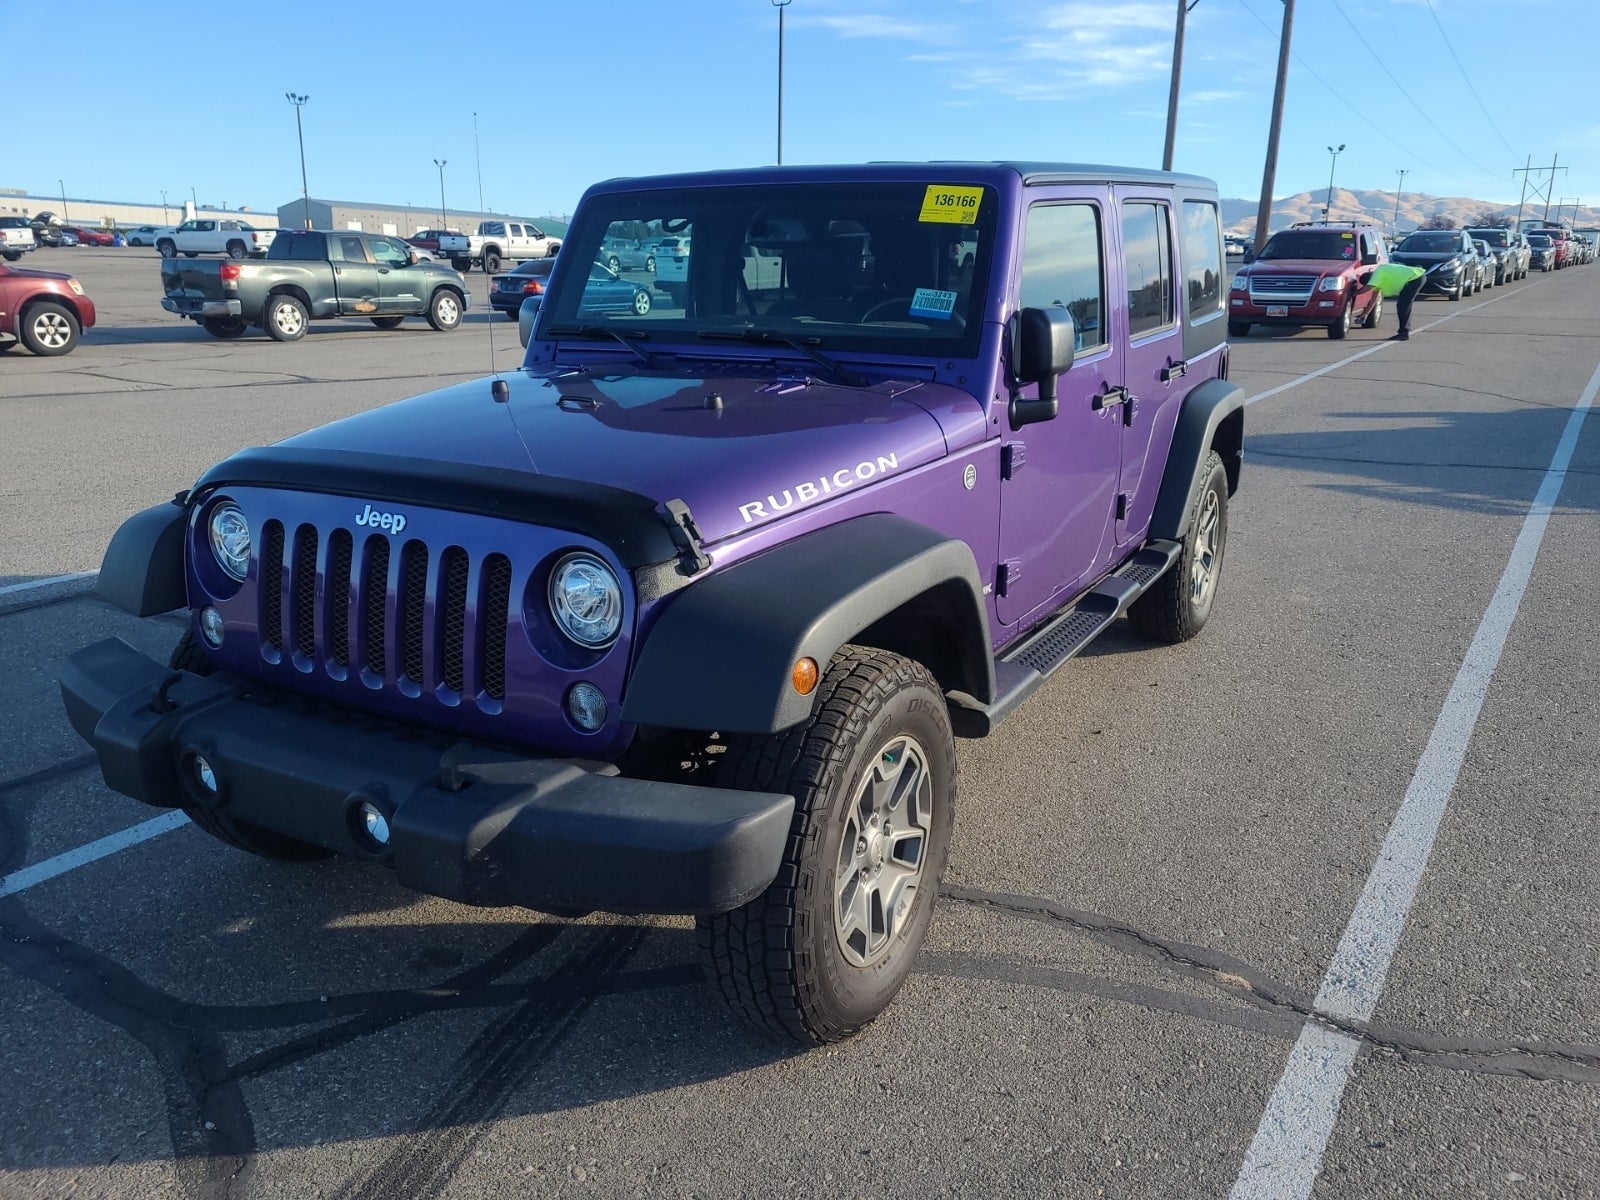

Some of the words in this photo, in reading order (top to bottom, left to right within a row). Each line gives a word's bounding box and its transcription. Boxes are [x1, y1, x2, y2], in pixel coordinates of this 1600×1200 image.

[935, 194, 977, 208] 136166
[738, 452, 899, 523] RUBICON
[355, 504, 407, 535] Jeep
